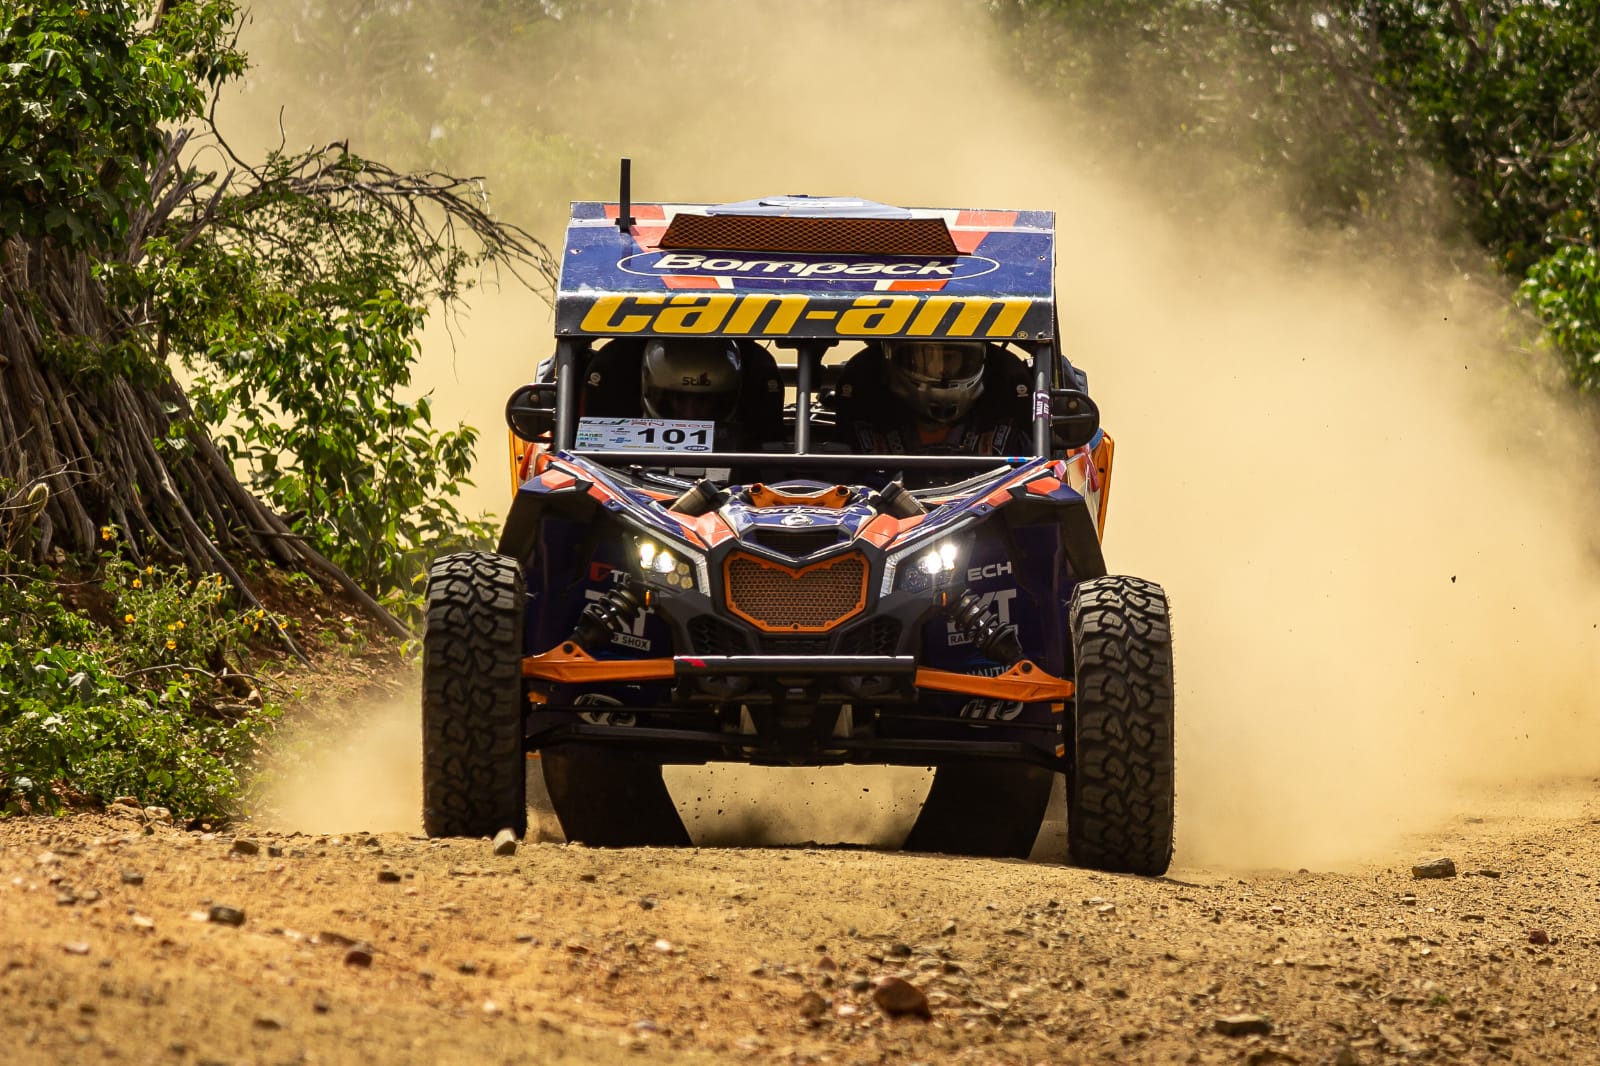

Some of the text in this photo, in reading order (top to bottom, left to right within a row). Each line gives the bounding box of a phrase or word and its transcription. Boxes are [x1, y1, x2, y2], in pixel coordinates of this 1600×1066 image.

[652, 253, 964, 278] Bompack
[580, 293, 1032, 336] can-am
[637, 428, 707, 444] 101
[967, 561, 1012, 582] ECH
[622, 635, 649, 649] SHOX
